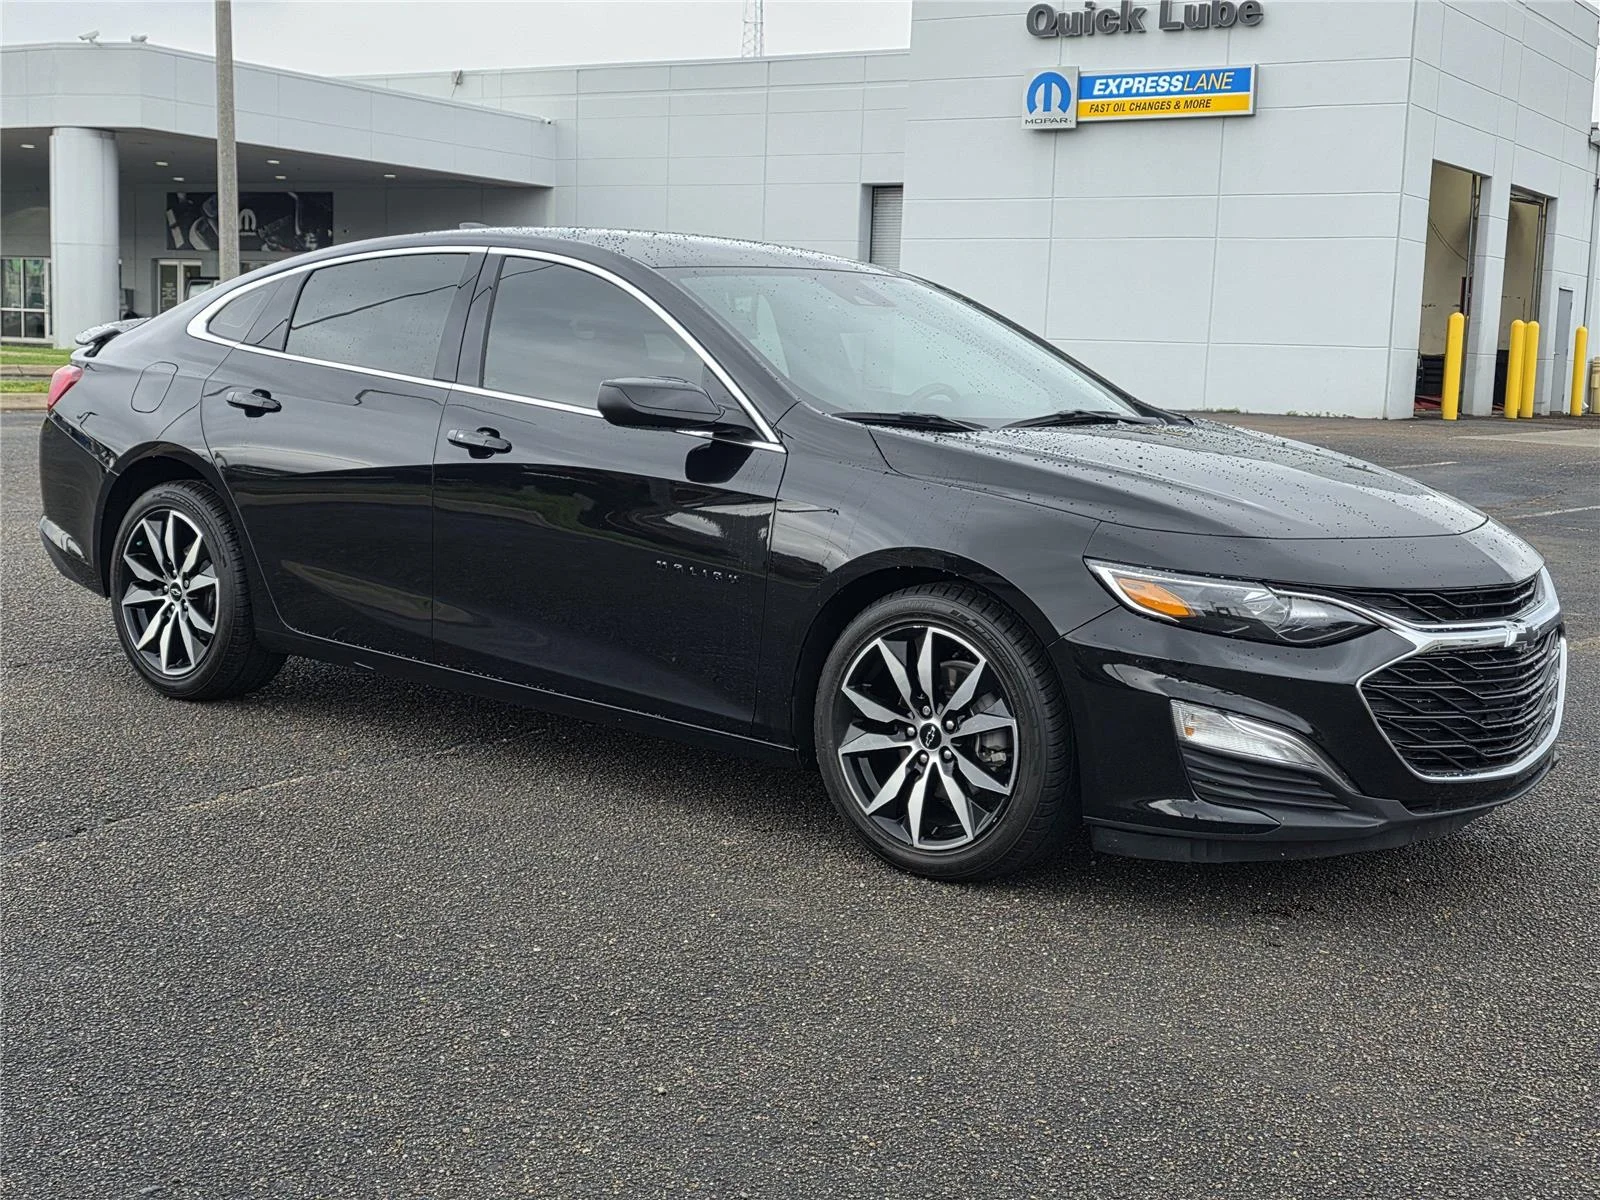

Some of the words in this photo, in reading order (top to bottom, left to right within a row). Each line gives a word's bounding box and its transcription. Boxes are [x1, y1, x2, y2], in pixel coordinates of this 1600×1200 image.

[1026, 0, 1147, 38] Quick
[1159, 0, 1264, 31] Lube
[1089, 103, 1111, 113] FAST
[1113, 102, 1126, 112] OIL
[1129, 101, 1172, 111] CHANGES
[1173, 100, 1181, 110] &
[1183, 99, 1212, 109] MORE
[1025, 117, 1068, 125] MOPAR
